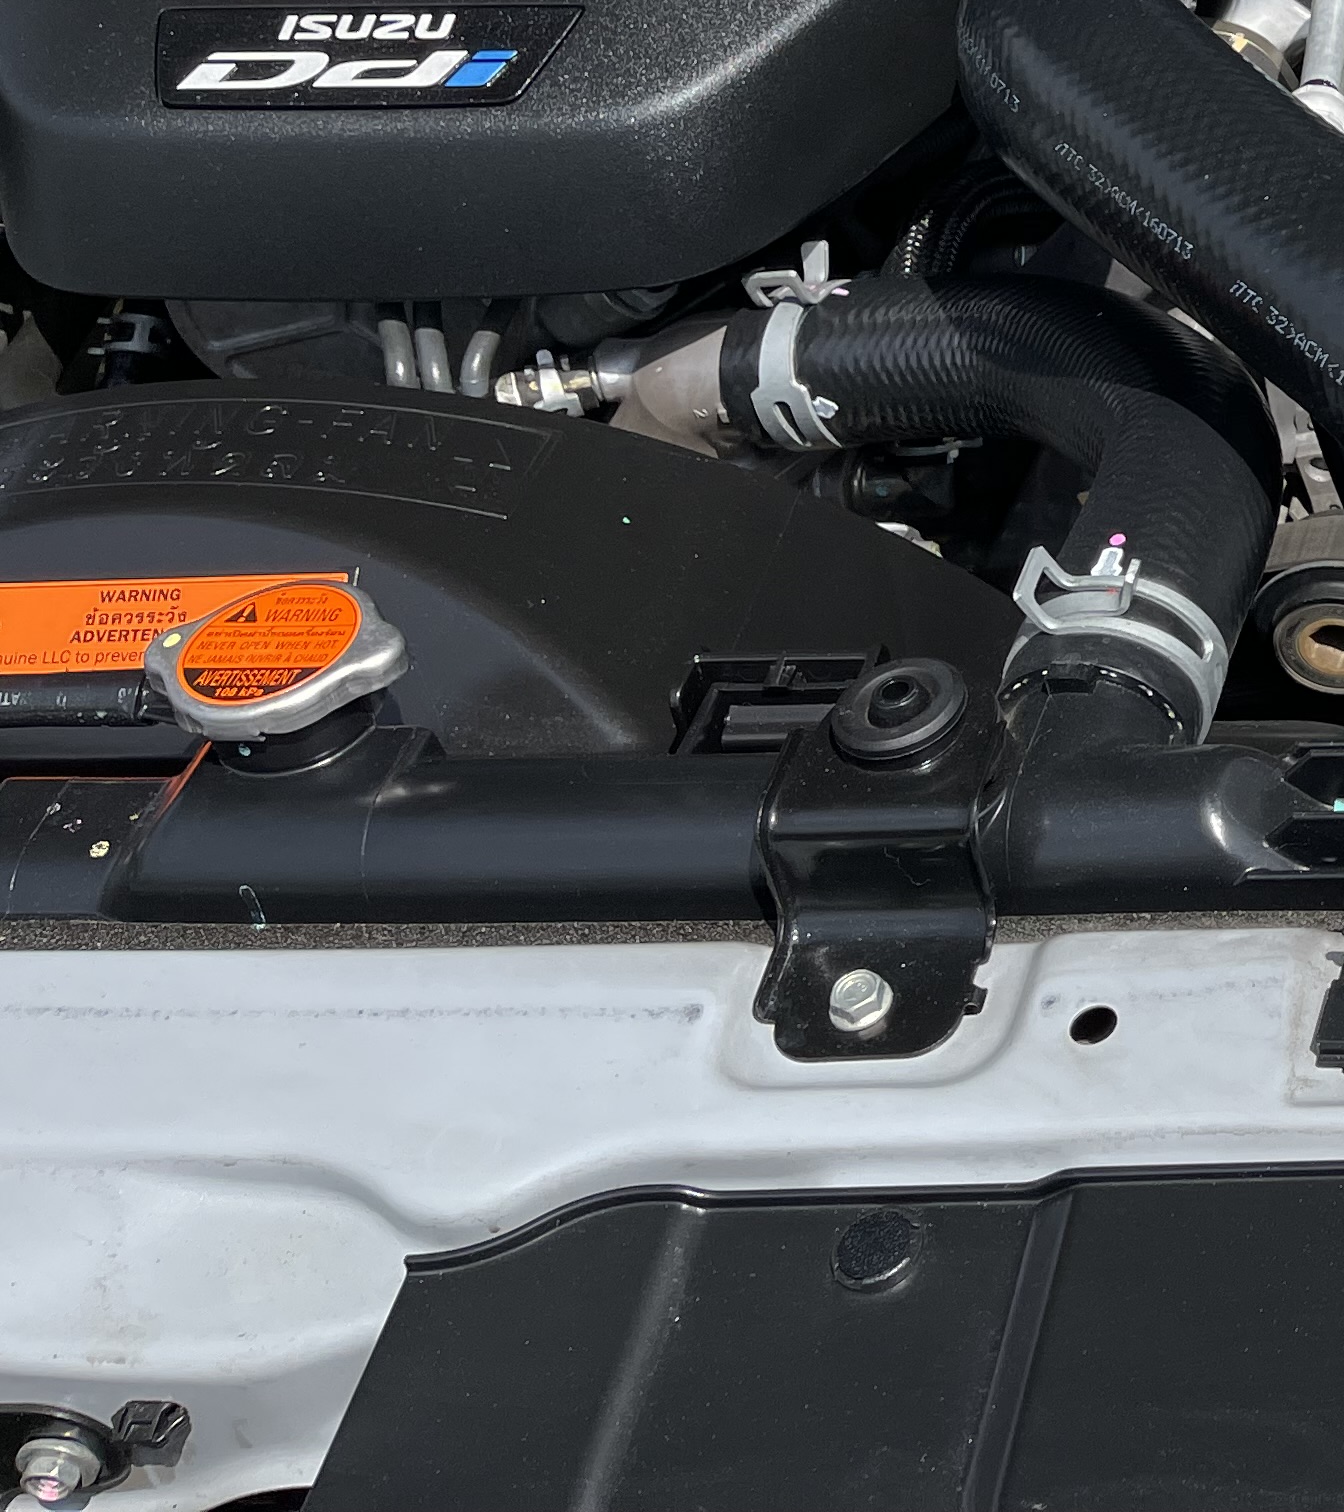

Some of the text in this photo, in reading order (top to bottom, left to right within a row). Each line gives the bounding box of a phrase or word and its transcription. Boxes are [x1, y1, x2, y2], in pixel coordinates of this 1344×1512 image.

[278, 13, 456, 41] ISUZU
[100, 588, 182, 603] WARNING
[85, 606, 188, 626] ข้อควรระวัง
[265, 608, 342, 623] WARNING
[196, 639, 339, 650] NEVER OPEN WHEN HOT
[42, 649, 72, 664] LLC
[75, 650, 91, 664] to
[187, 654, 205, 664] NE
[204, 653, 243, 664] JAMAIS
[294, 653, 328, 663] CHAUD
[193, 669, 302, 686] AVERTISSEMENT
